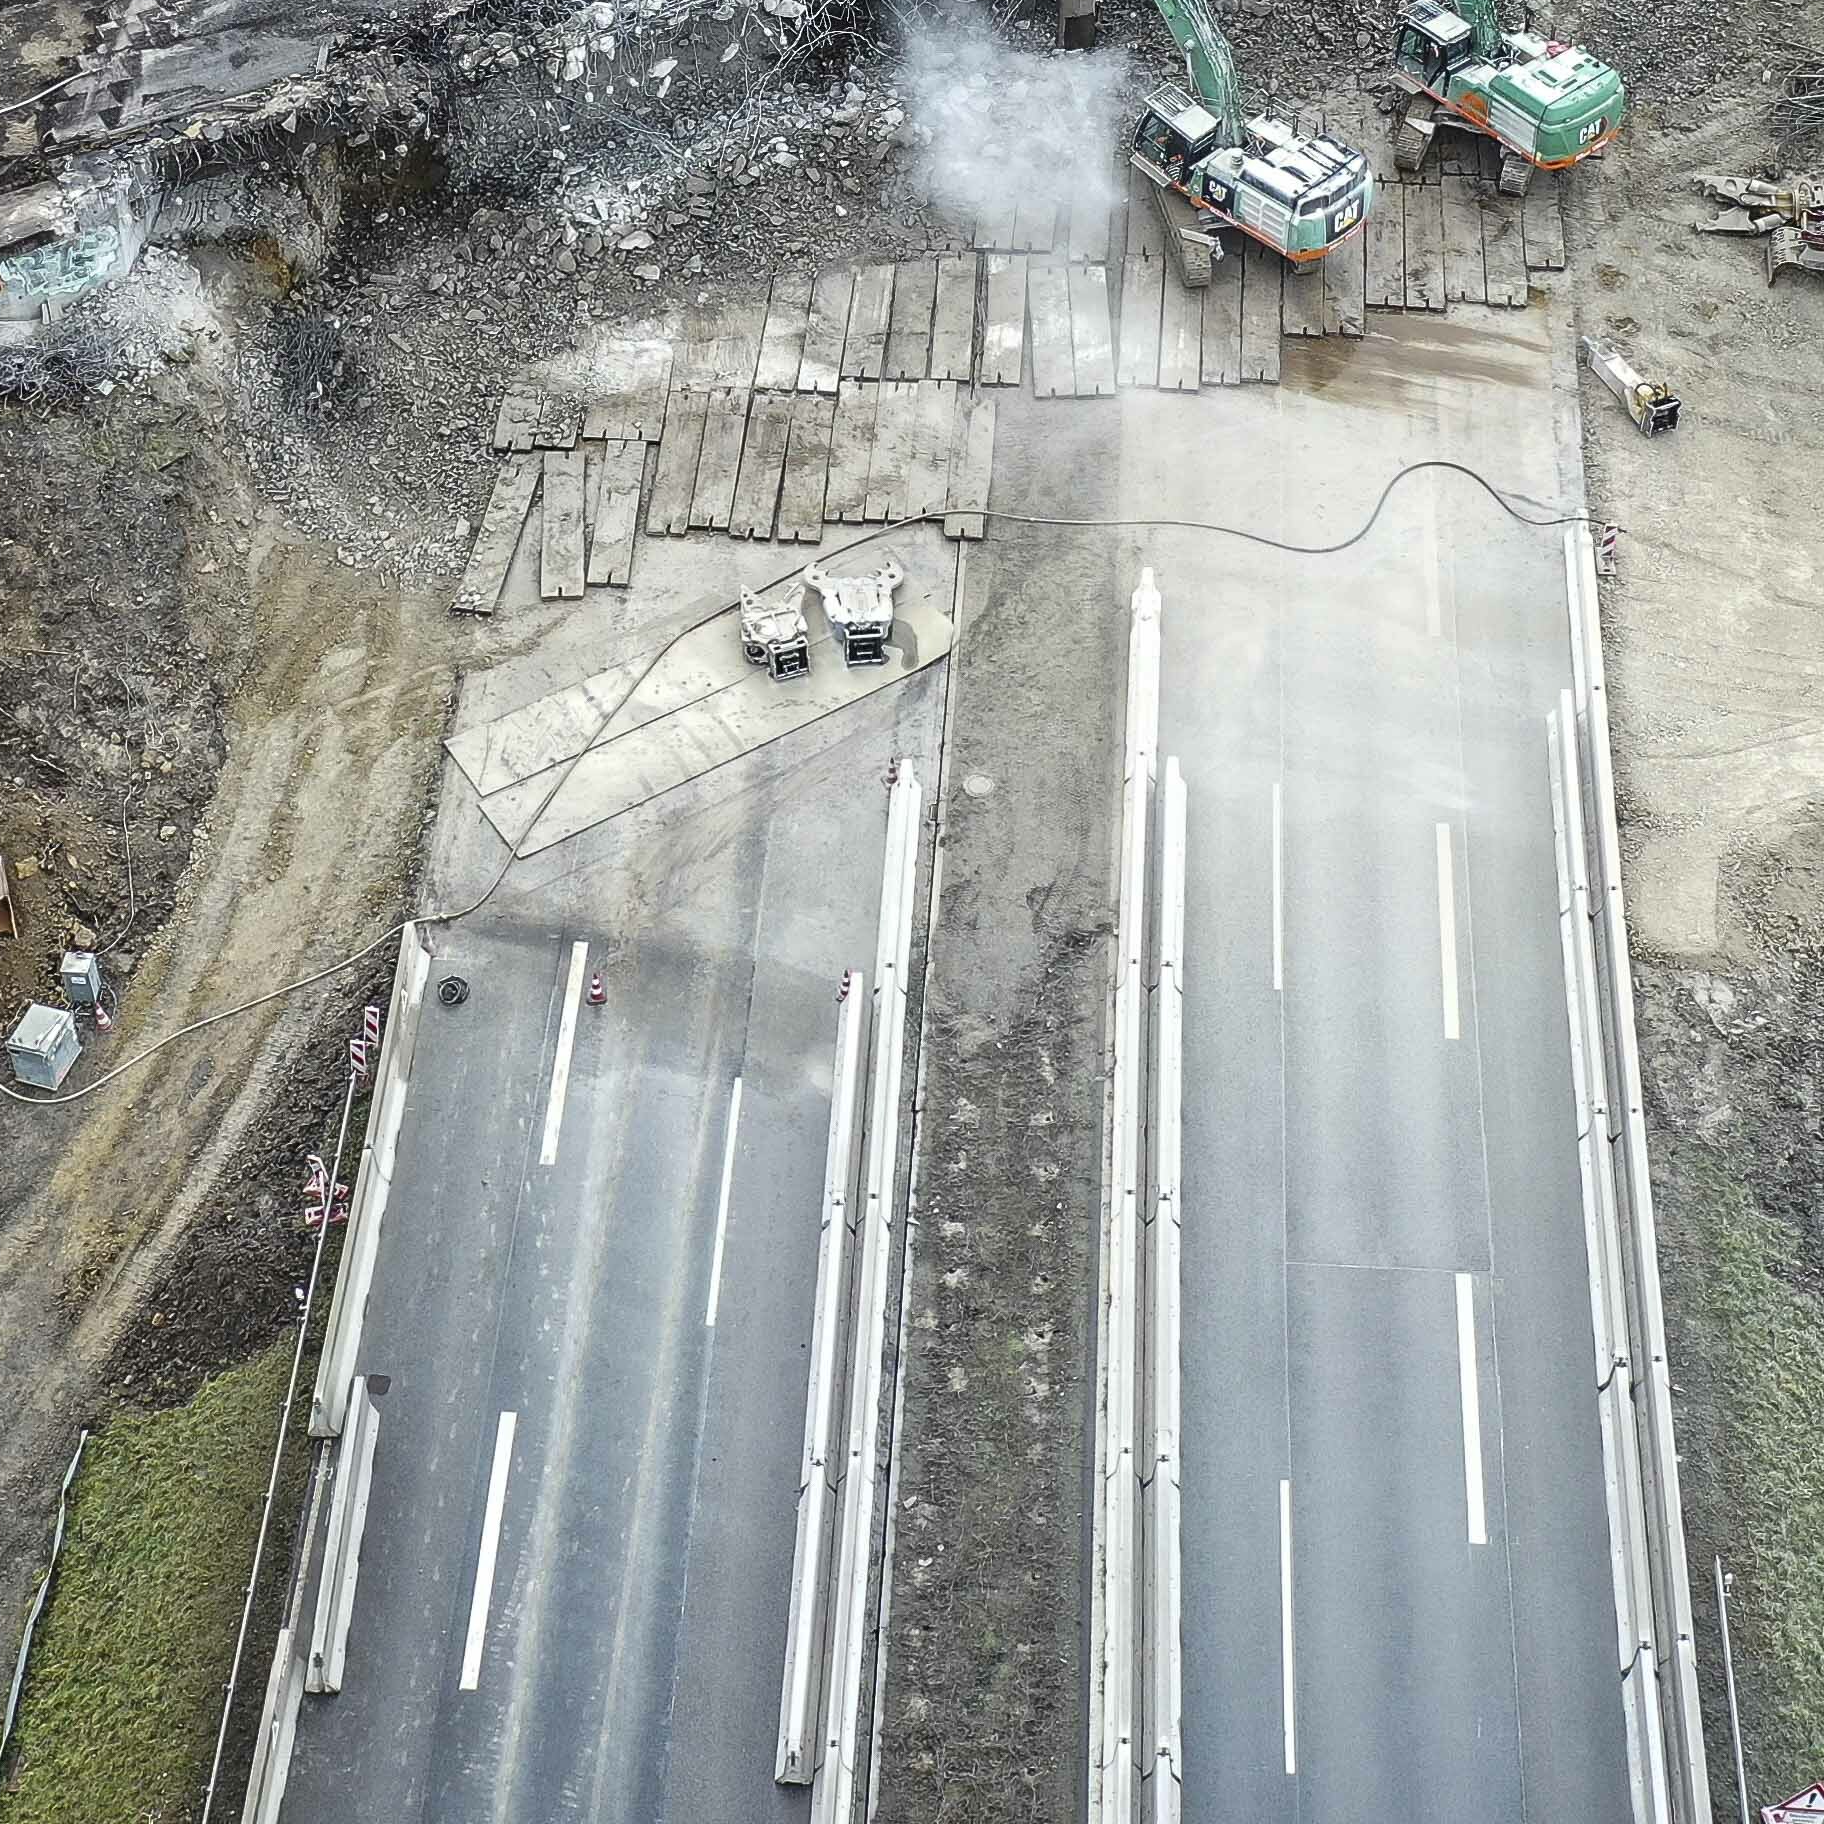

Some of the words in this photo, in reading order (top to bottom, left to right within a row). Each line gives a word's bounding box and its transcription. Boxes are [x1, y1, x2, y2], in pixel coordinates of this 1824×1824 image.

[1578, 117, 1603, 145] CAT
[1208, 179, 1229, 202] CAT
[1334, 198, 1360, 234] CAT
